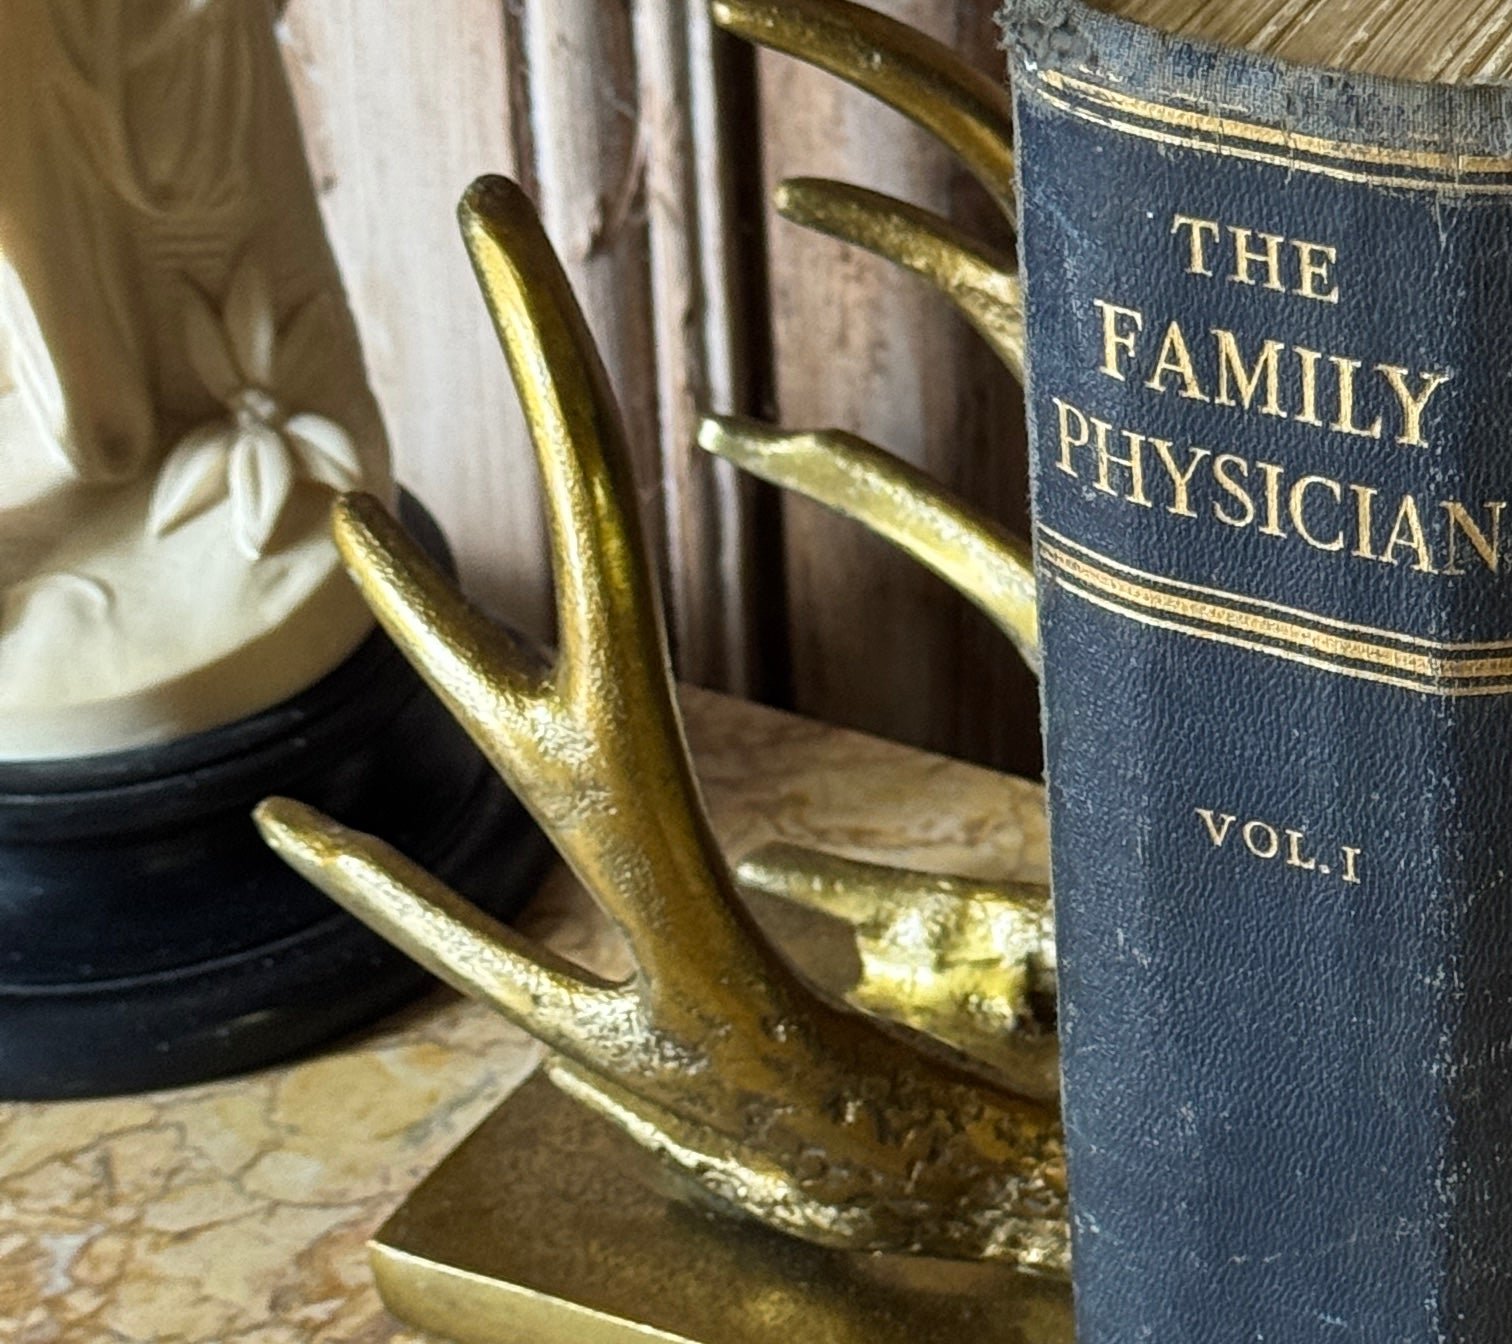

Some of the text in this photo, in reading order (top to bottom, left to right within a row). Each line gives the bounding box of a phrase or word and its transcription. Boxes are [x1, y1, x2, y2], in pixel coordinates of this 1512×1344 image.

[1170, 213, 1340, 304] THE
[1093, 299, 1450, 448] FAMILY
[1052, 397, 1507, 575] PHYSICIAN
